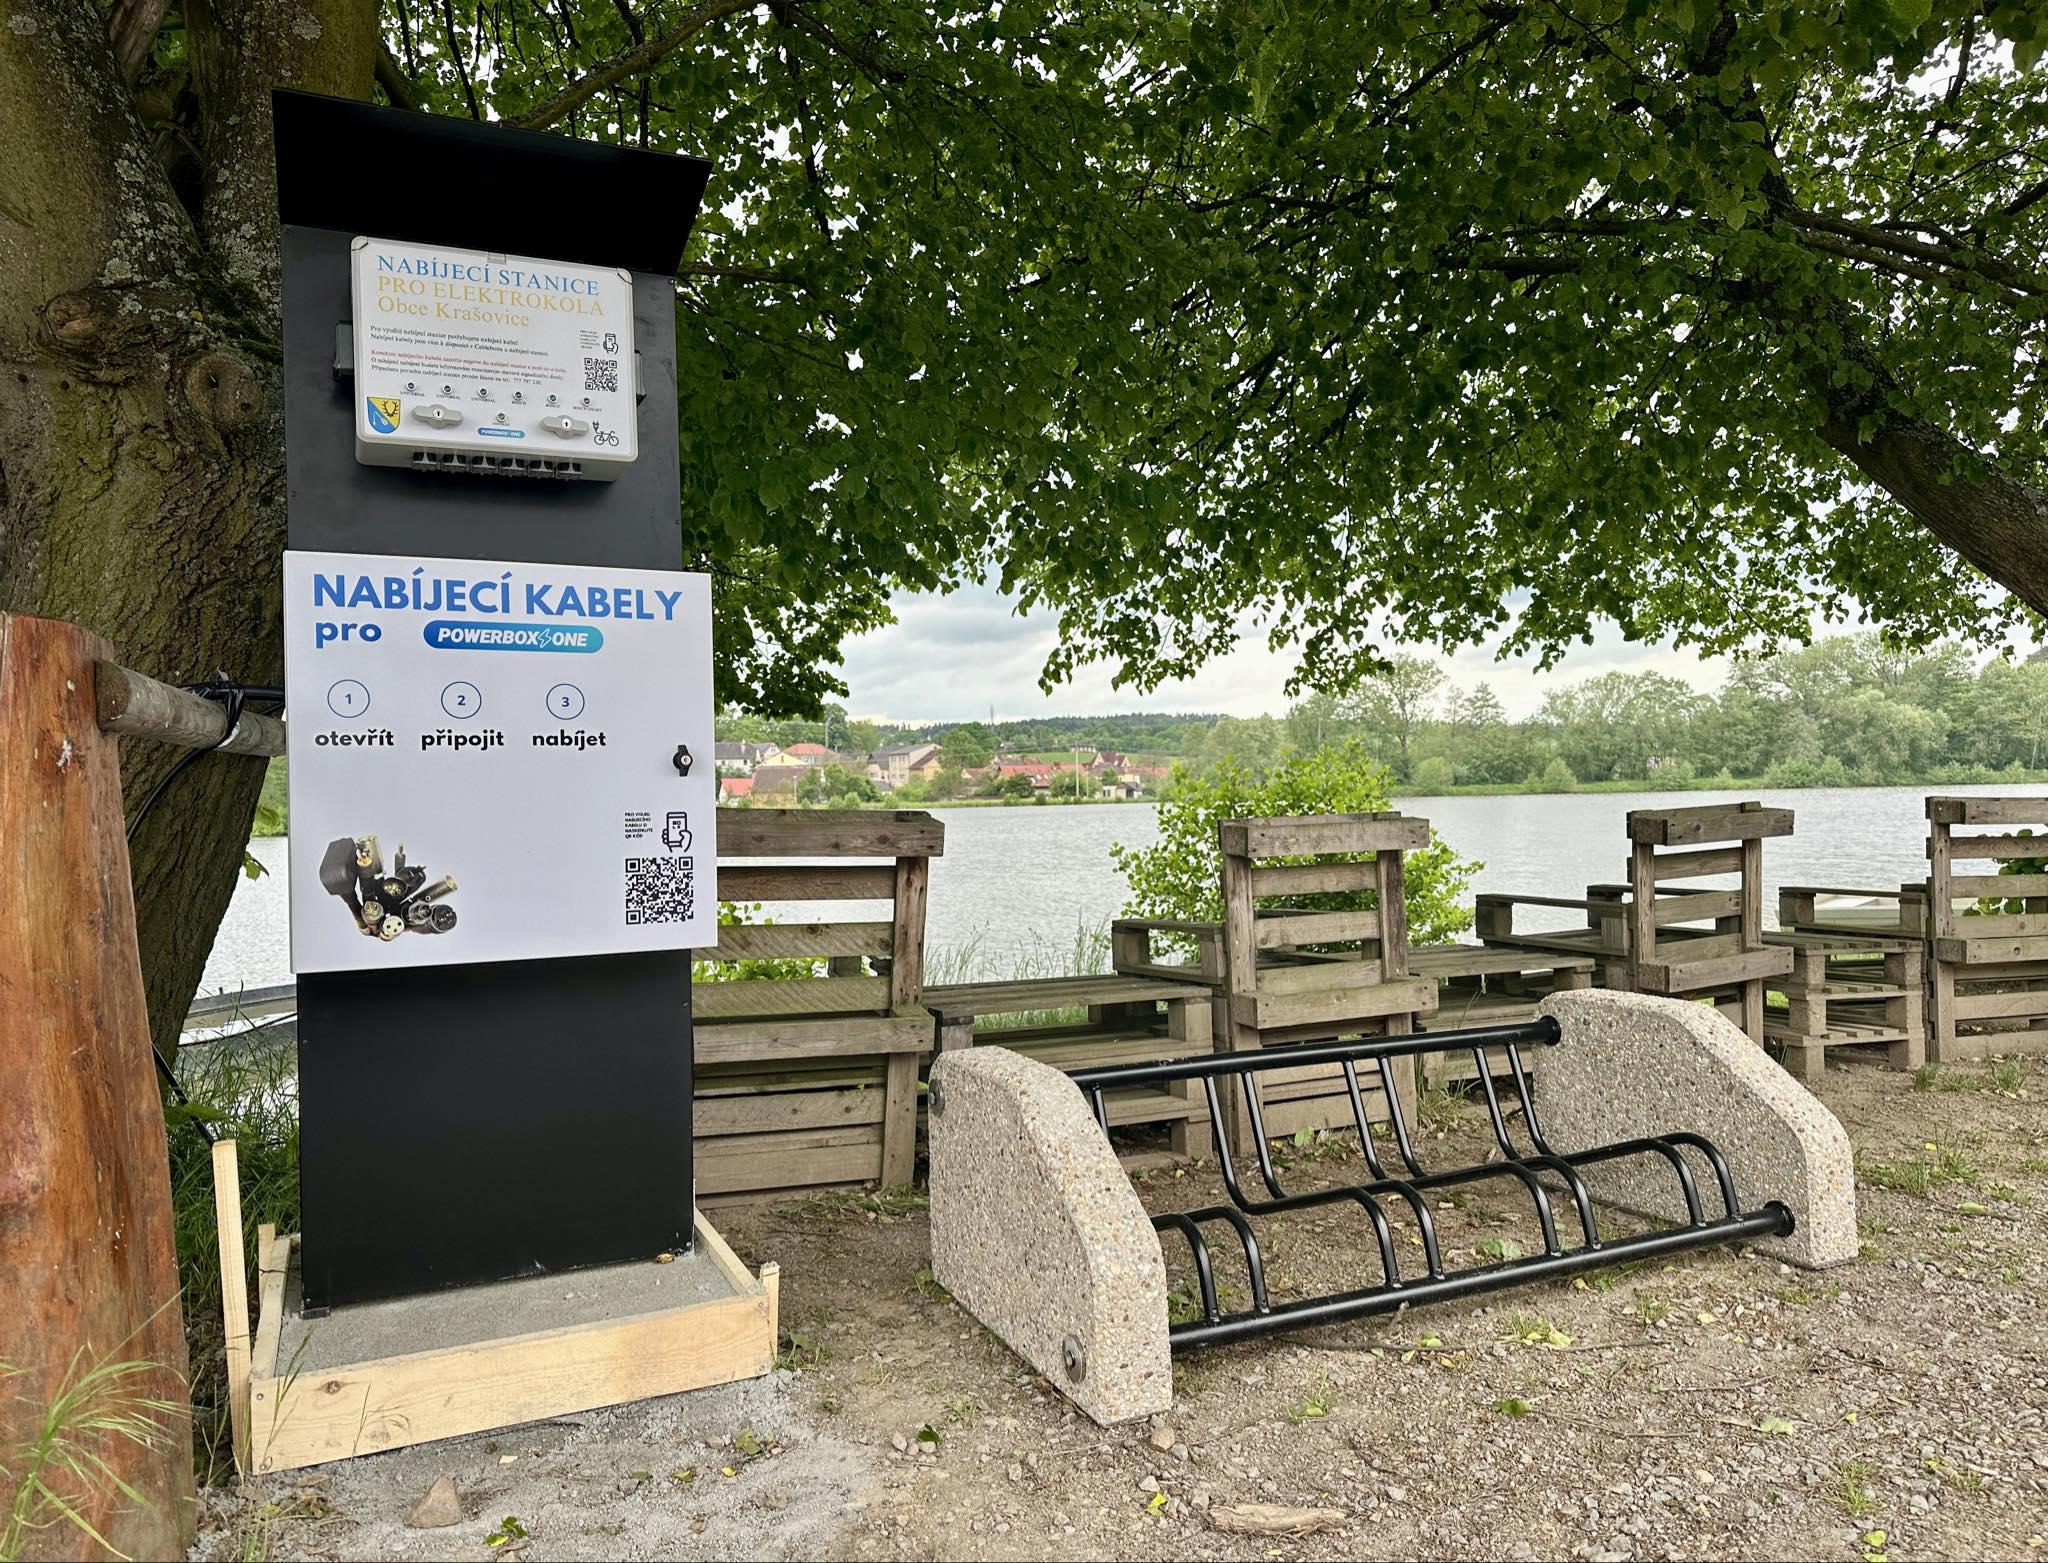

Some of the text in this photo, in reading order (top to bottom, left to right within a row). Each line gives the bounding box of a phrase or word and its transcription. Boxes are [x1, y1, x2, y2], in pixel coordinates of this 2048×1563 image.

[377, 255, 599, 296] NABÍJECÍ STANICE
[378, 276, 604, 315] PRO ELEKTROKOLA
[378, 296, 529, 326] Obce Krašovice
[313, 566, 682, 620] NABÍJECÍ KABELY
[316, 621, 588, 648] pro POWERBOX ONE
[345, 693, 352, 704] 1
[457, 694, 466, 706] 2
[561, 696, 570, 708] 3
[315, 728, 394, 746] otevřít
[421, 730, 504, 750] připojit
[532, 730, 606, 750] nabíjet
